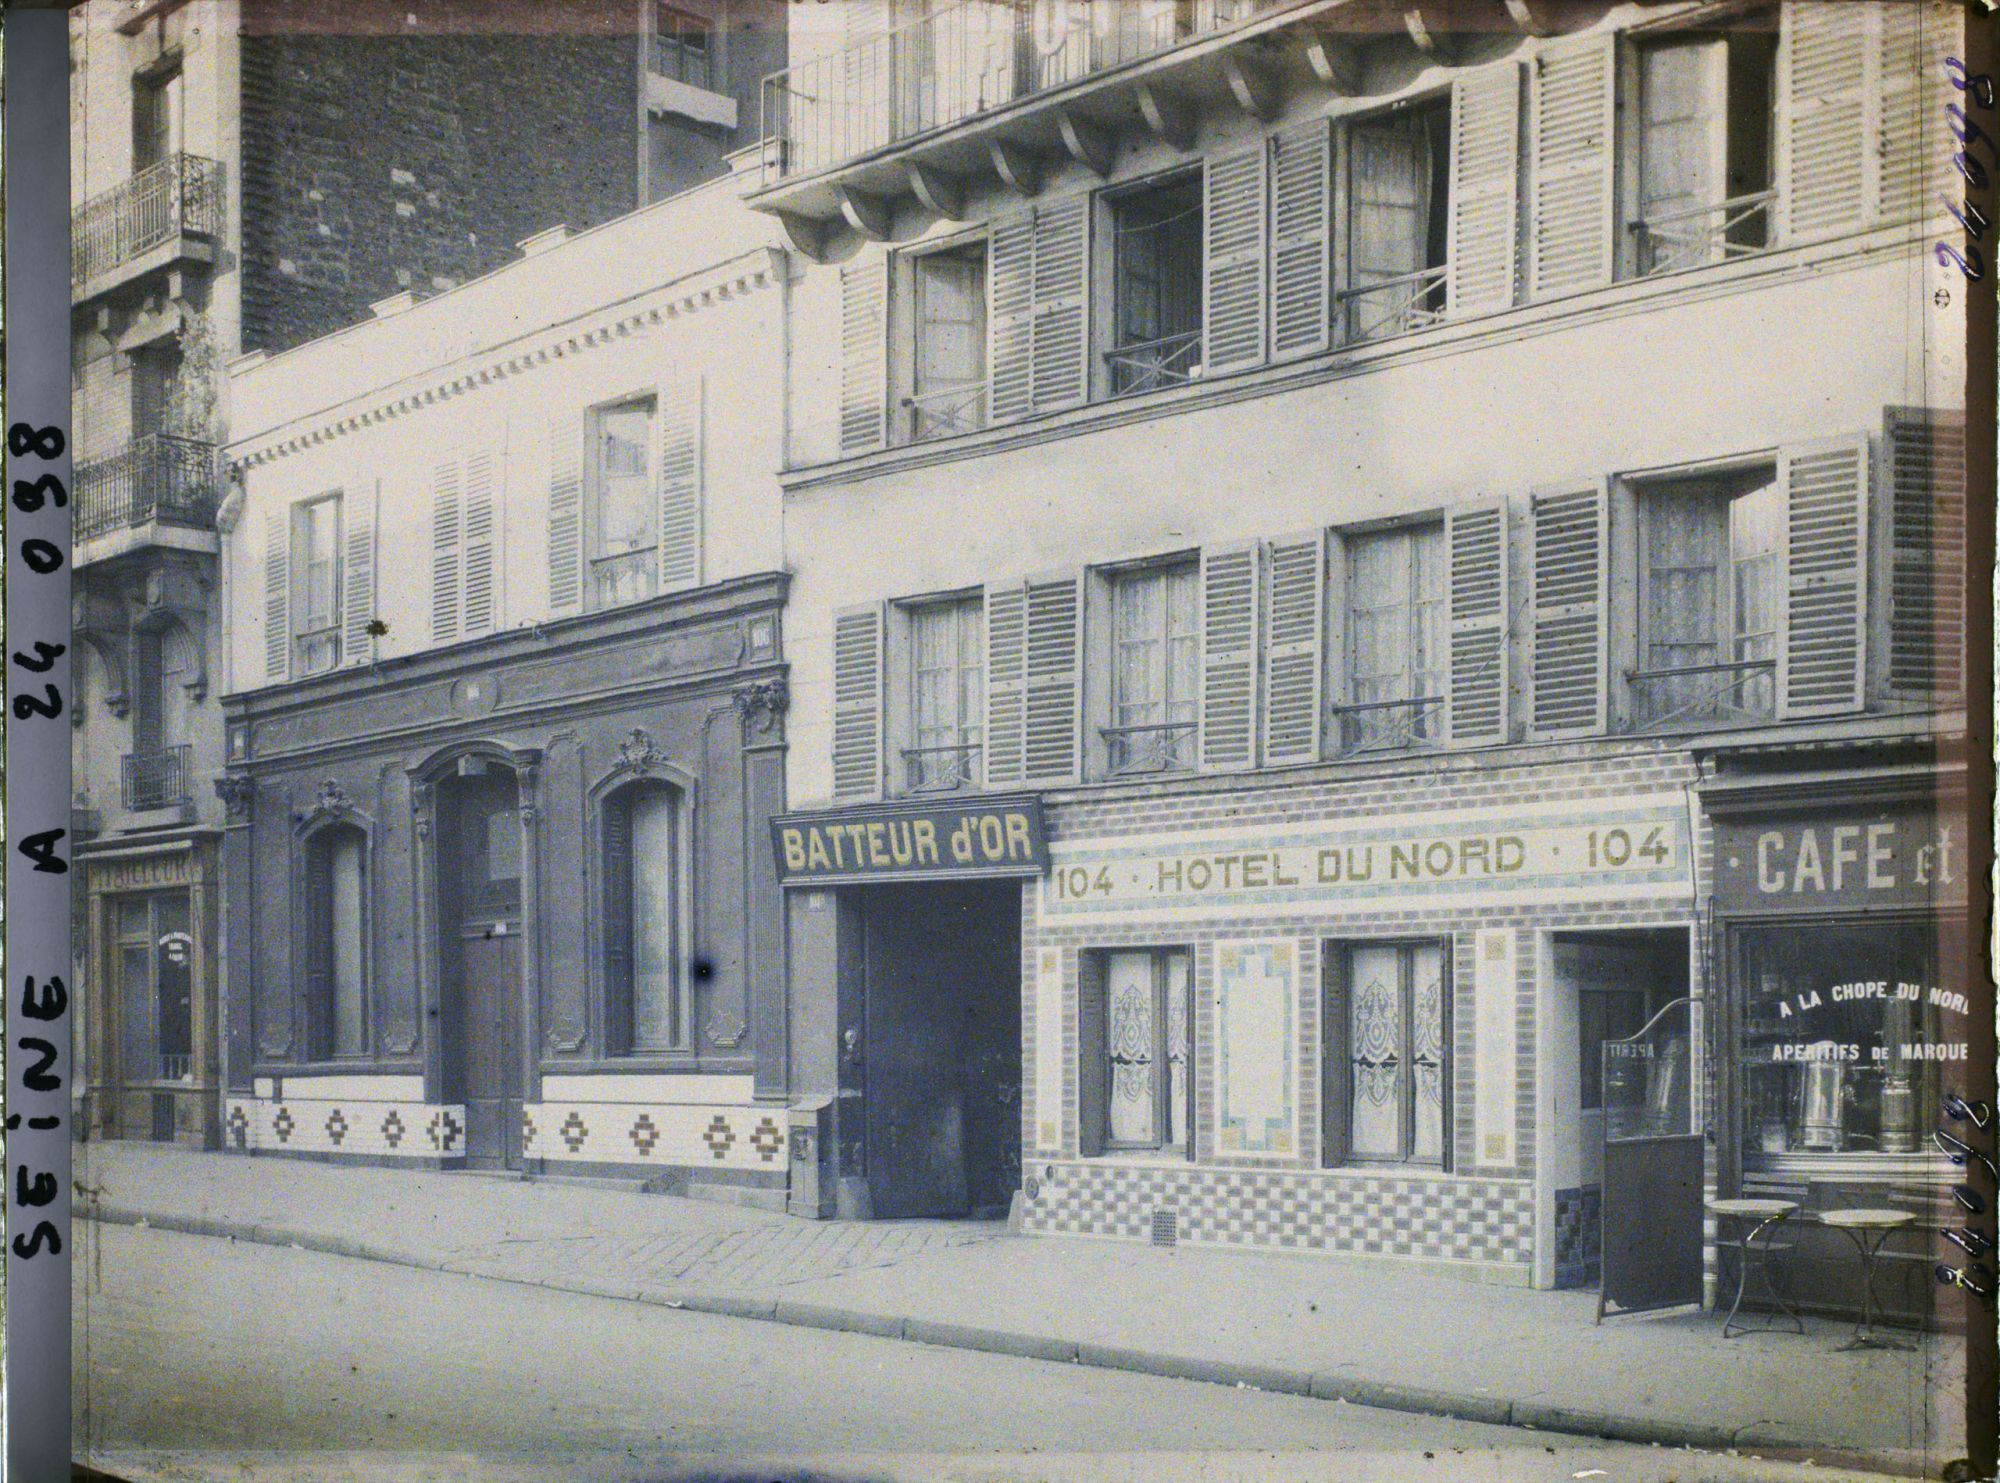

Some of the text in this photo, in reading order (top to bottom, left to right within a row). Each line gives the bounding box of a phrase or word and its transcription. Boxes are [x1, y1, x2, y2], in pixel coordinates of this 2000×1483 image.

[13, 641, 66, 720] 24
[18, 828, 68, 873] A
[782, 813, 1032, 871] BATTEUR d'OR
[1056, 826, 1669, 898] 104 HOTEL DU NORD 104
[1914, 825, 1956, 885] et
[1779, 1001, 1793, 1018] A
[1798, 990, 1822, 1010] LA
[1832, 982, 1888, 1001] CHOPE
[1898, 982, 1920, 1000] DU
[1872, 1047, 1889, 1060] DE
[1901, 1043, 1968, 1061] MARQUE
